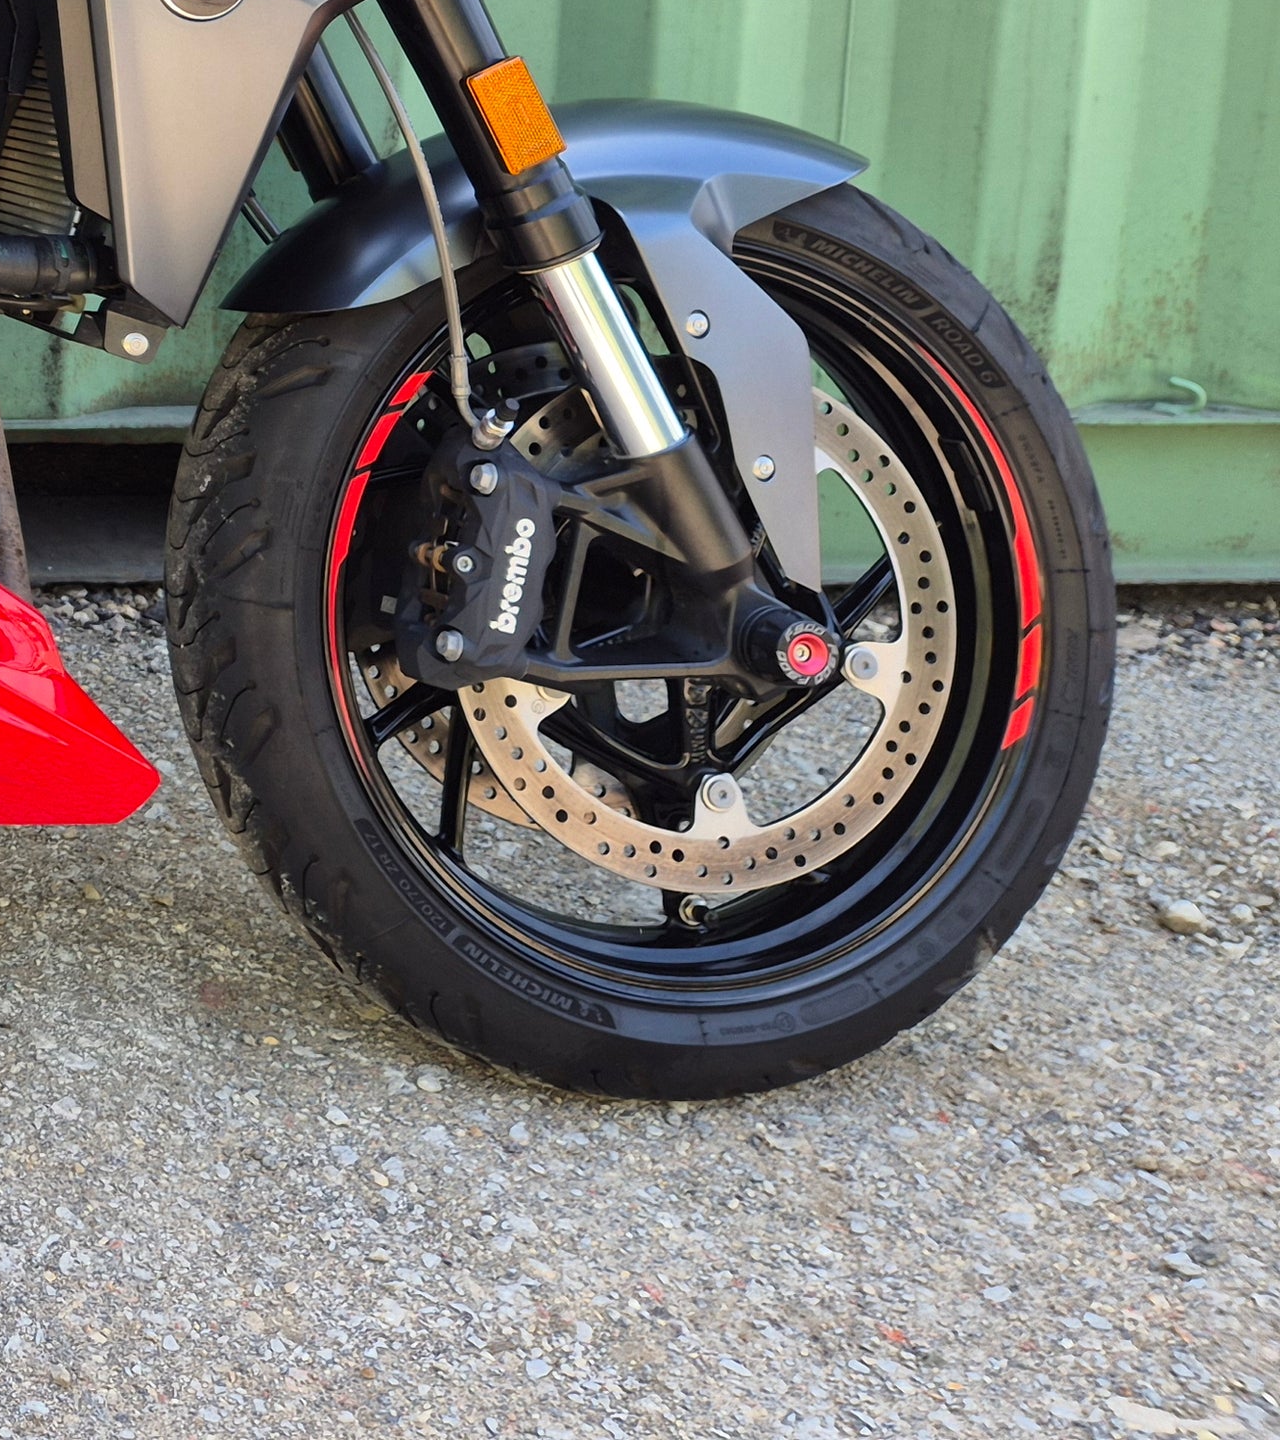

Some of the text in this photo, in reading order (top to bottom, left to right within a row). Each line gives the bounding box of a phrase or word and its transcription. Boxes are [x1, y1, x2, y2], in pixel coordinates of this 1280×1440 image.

[811, 238, 997, 384] MICHELIN ROAD 6
[489, 518, 536, 635] brembo
[463, 940, 574, 1012] MICHELIN
